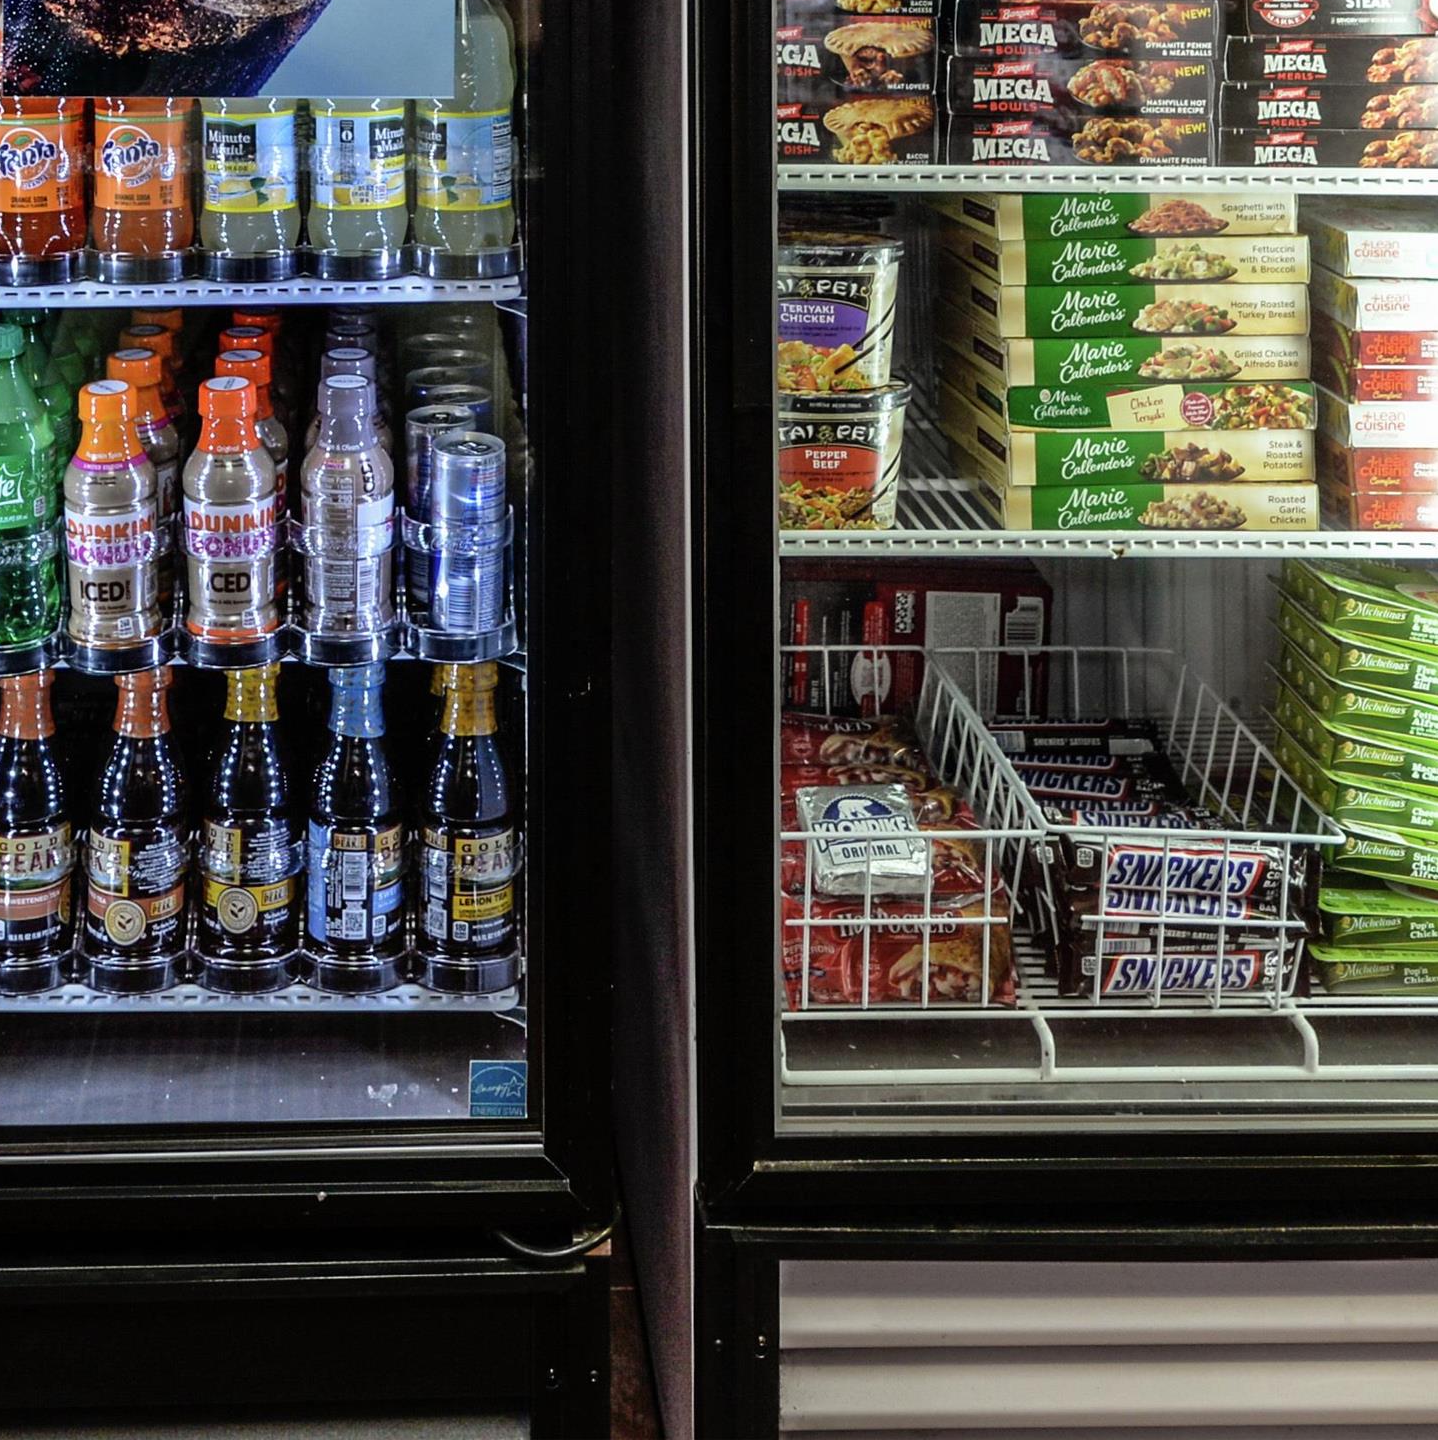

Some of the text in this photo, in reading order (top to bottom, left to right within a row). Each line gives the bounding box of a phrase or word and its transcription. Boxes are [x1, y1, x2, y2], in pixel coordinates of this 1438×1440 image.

[1181, 8, 1211, 21] NEW!
[1266, 13, 1308, 25] MARKET
[979, 23, 1058, 47] MEGA
[995, 46, 1041, 55] BOWLS
[1264, 55, 1327, 73] MEGA
[1175, 65, 1205, 78] NEW!
[973, 79, 1054, 103] MEGA
[990, 103, 1037, 112] BOWLS
[1147, 99, 1189, 107] NASHVILLE
[1141, 106, 1176, 114] CHICKEN
[1257, 101, 1321, 120] MEGA
[1271, 118, 1307, 126] MEALS
[1176, 123, 1206, 136] NEW!
[972, 138, 1050, 161] MEGA
[1254, 147, 1318, 165] MEGA
[102, 139, 160, 179] Fanta
[1050, 197, 1114, 220] Marie
[1222, 204, 1263, 212] Spaghetti
[1050, 213, 1119, 237] Callender's
[1052, 241, 1120, 265] Marie
[1253, 245, 1295, 253] Fettuccini
[1052, 259, 1127, 283] Callender's
[780, 303, 834, 314] TERIYAKI
[1051, 290, 1120, 315] Marie
[1231, 300, 1295, 310] Honey Roasted
[780, 313, 835, 324] CHICKEN
[1051, 309, 1126, 332] Callender's
[1238, 311, 1266, 319] Turkey
[1060, 342, 1126, 366] Marie
[1234, 350, 1262, 358] Grilled
[1060, 359, 1132, 384] Callender's
[1051, 389, 1082, 406] Marie
[1130, 397, 1163, 410] Chicken
[1033, 405, 1091, 421] Callender's
[1134, 411, 1166, 424] Teriyaki
[779, 425, 813, 441] TAI
[217, 445, 239, 453] Original
[805, 449, 848, 459] PEPPER
[1062, 437, 1130, 461] Marie
[1266, 451, 1303, 459] Roasted
[812, 459, 841, 469] BEEF
[1062, 456, 1135, 479] Callender's
[1058, 488, 1128, 511] Marie
[1058, 507, 1133, 529] Callender's
[1270, 516, 1306, 524] Chicken
[80, 580, 125, 602] ICED
[495, 892, 507, 902] TEA
